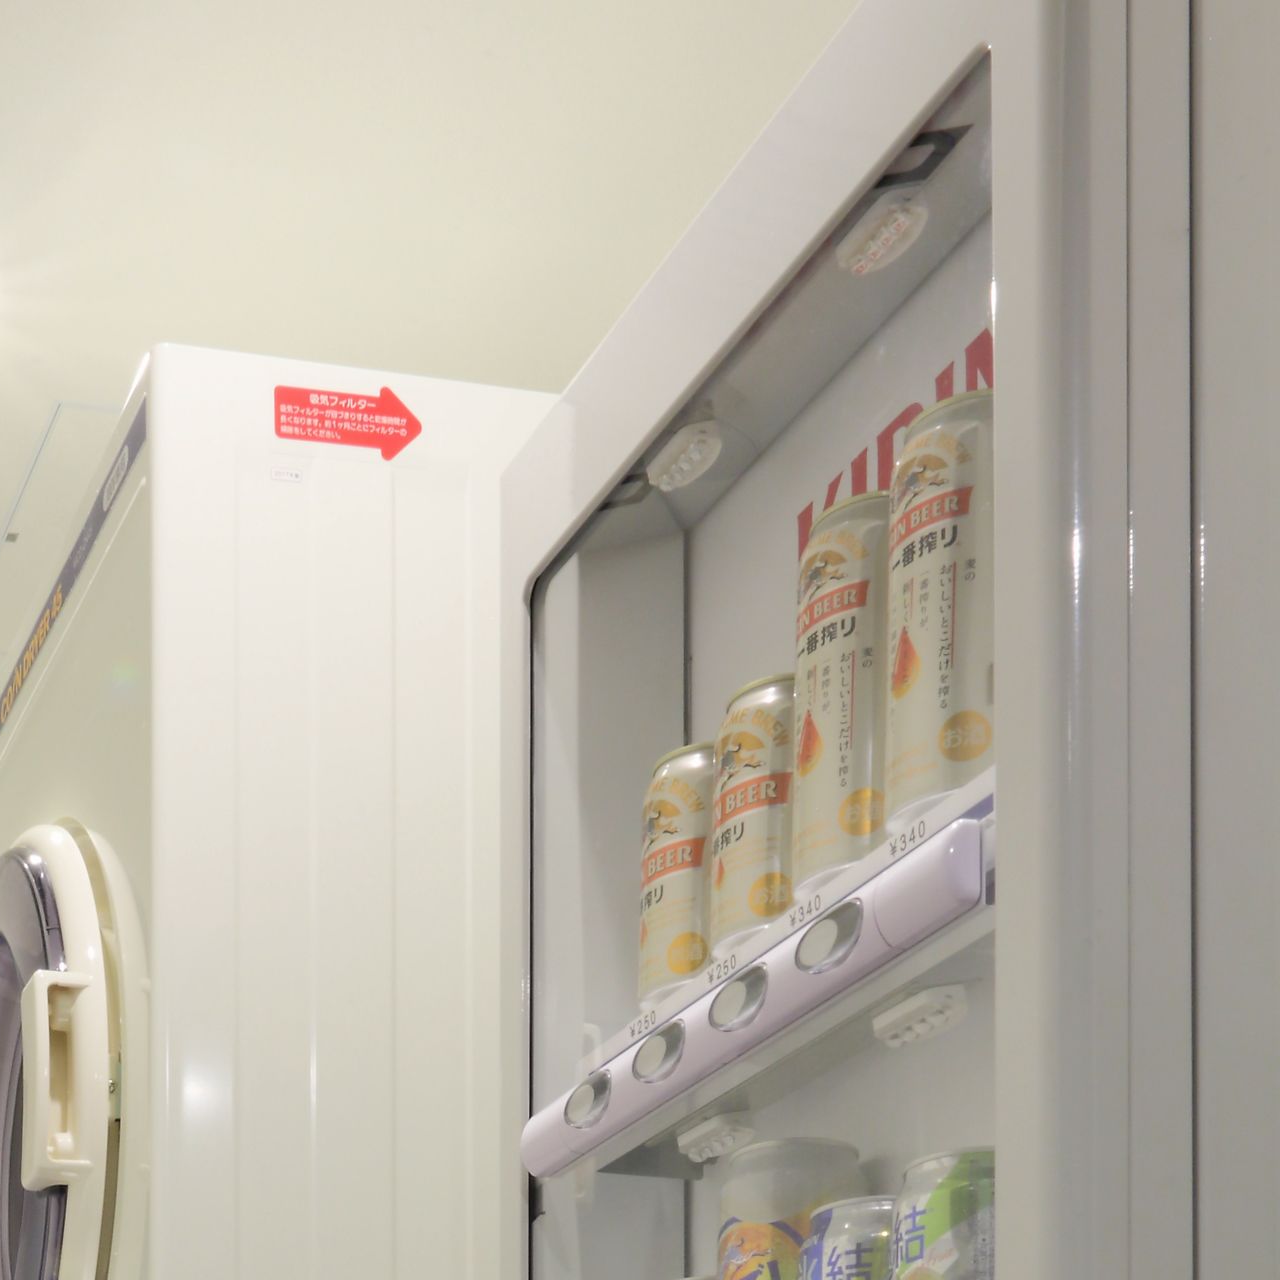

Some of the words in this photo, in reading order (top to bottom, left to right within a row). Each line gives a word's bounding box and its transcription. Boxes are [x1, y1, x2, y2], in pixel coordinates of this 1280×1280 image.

[910, 495, 960, 528] BEER
[892, 524, 960, 571] 一番搾り
[813, 589, 858, 618] BEER
[797, 615, 857, 658] 一番搾り
[725, 779, 778, 814] BEER
[889, 820, 926, 858] ¥340
[647, 845, 694, 878] BEER
[789, 894, 822, 929] ¥340
